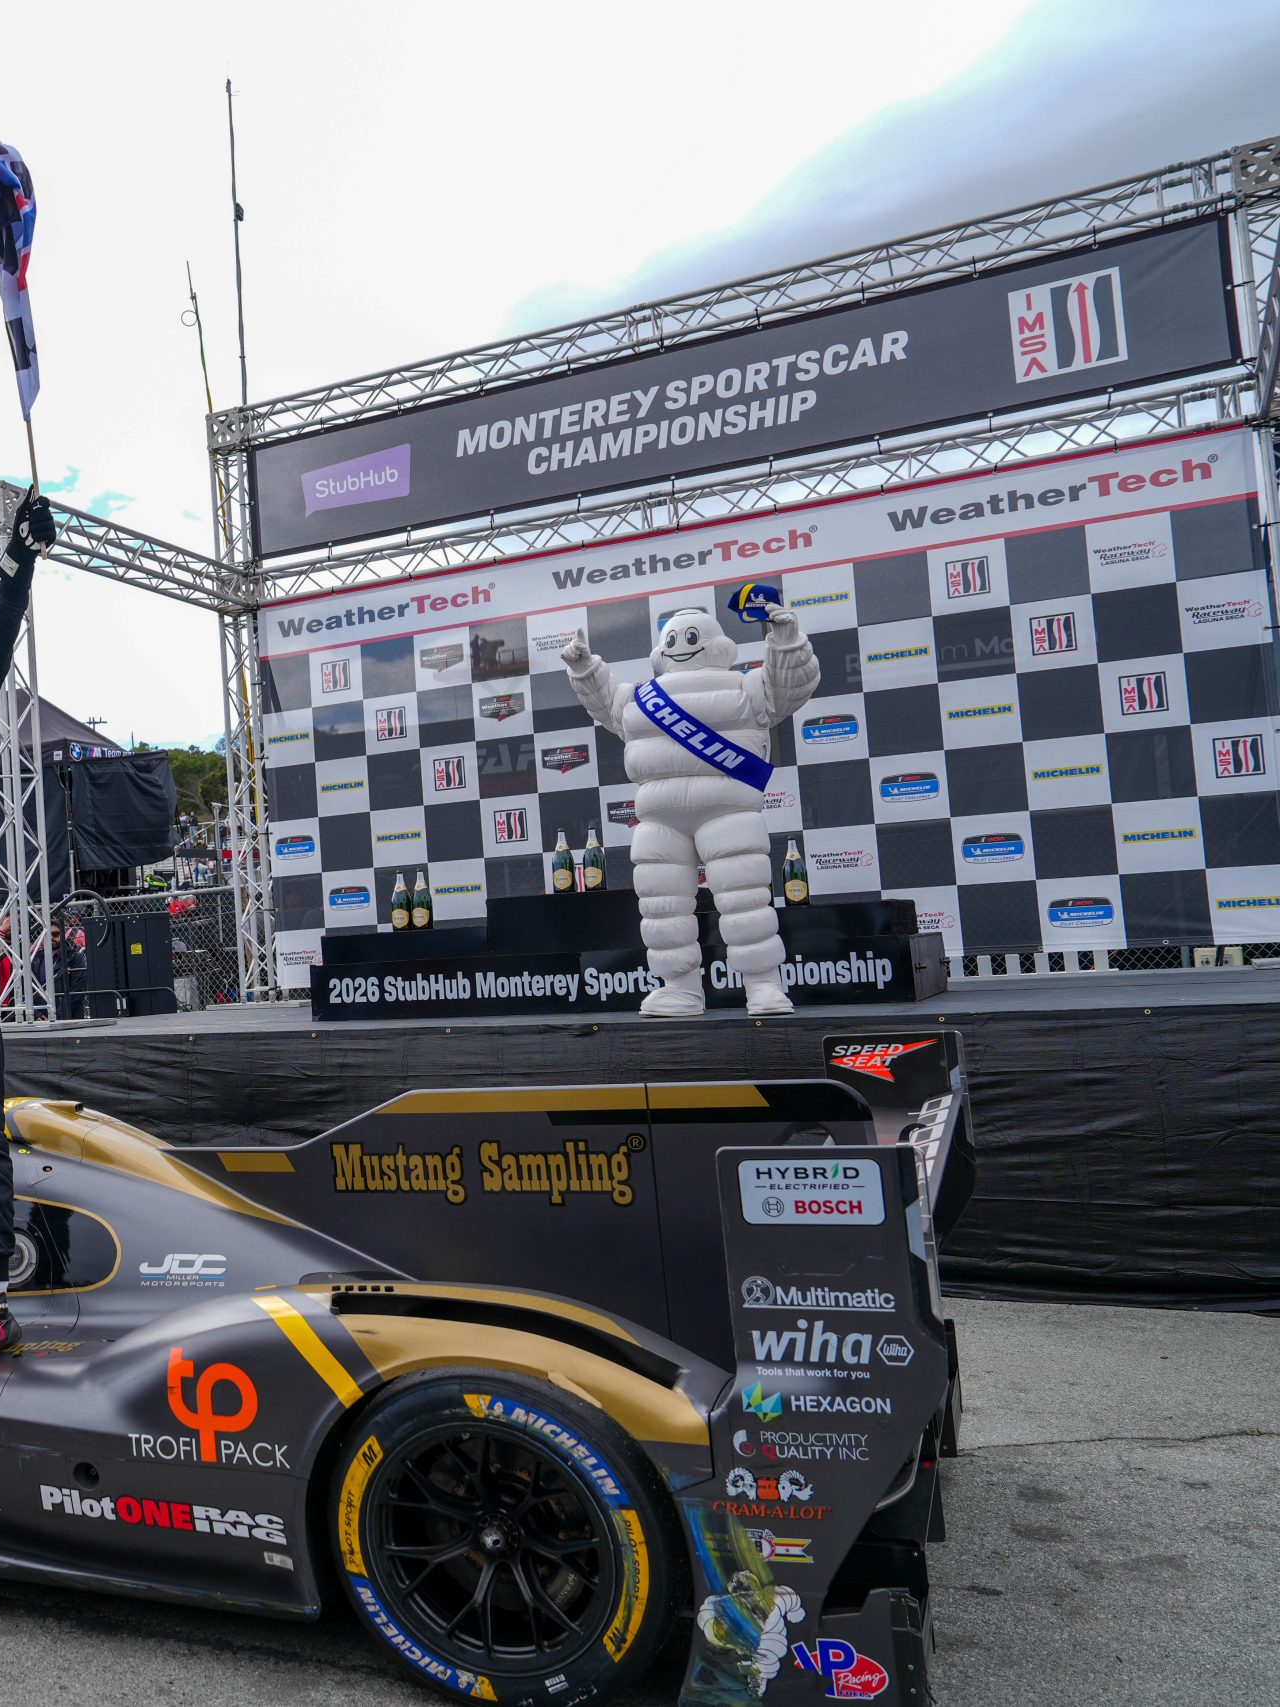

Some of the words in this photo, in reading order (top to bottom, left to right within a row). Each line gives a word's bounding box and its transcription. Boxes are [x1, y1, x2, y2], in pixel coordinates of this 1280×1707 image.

[456, 386, 658, 457] MONTEREY
[665, 330, 909, 408] SPORTSCAR
[526, 390, 816, 476] CHAMPIONSHIP
[314, 463, 398, 499] StubHub
[1100, 557, 1130, 566] LAGUNA
[790, 593, 848, 608] MICHELIN
[1193, 616, 1224, 625] LAGUNA
[867, 648, 928, 662] MICHELIN
[948, 705, 1012, 719] MICHELIN
[637, 681, 745, 770] MICHELIN
[269, 733, 309, 743] MICHELIN
[1033, 766, 1100, 779] MICHELIN
[321, 781, 363, 792] MICHELIN
[376, 831, 421, 842] MICHELIN
[1123, 830, 1194, 841] MICHELIN
[435, 885, 481, 894] MICHELIN
[1218, 899, 1280, 908] MICHELI
[329, 976, 379, 1004] 2026
[384, 971, 469, 1001] StubHub
[476, 967, 579, 1003] Monterey
[832, 1044, 904, 1056] SPEED
[840, 1056, 897, 1067] SEAT
[332, 1142, 466, 1205] Mustang
[479, 1140, 634, 1205] Sampling
[794, 1200, 863, 1215] BOSCH
[775, 1286, 895, 1309] Multimatic
[752, 1319, 872, 1365] wiha
[756, 1366, 783, 1377] Tools
[785, 1368, 805, 1377] that
[806, 1368, 832, 1378] work
[833, 1369, 848, 1378] for
[850, 1371, 870, 1380] you
[790, 1395, 892, 1414] HEXAGON
[760, 1431, 868, 1446] PRODUCTIVITY
[128, 1433, 197, 1462] TROFI
[221, 1440, 291, 1470] PACK
[510, 1407, 620, 1496] MICHELIN
[761, 1444, 833, 1460] QUALITY
[838, 1448, 869, 1461] INC
[713, 1501, 825, 1520] CRAM-A-LOT
[356, 1585, 452, 1681] MICHELIN
[837, 1671, 885, 1690] Racing
